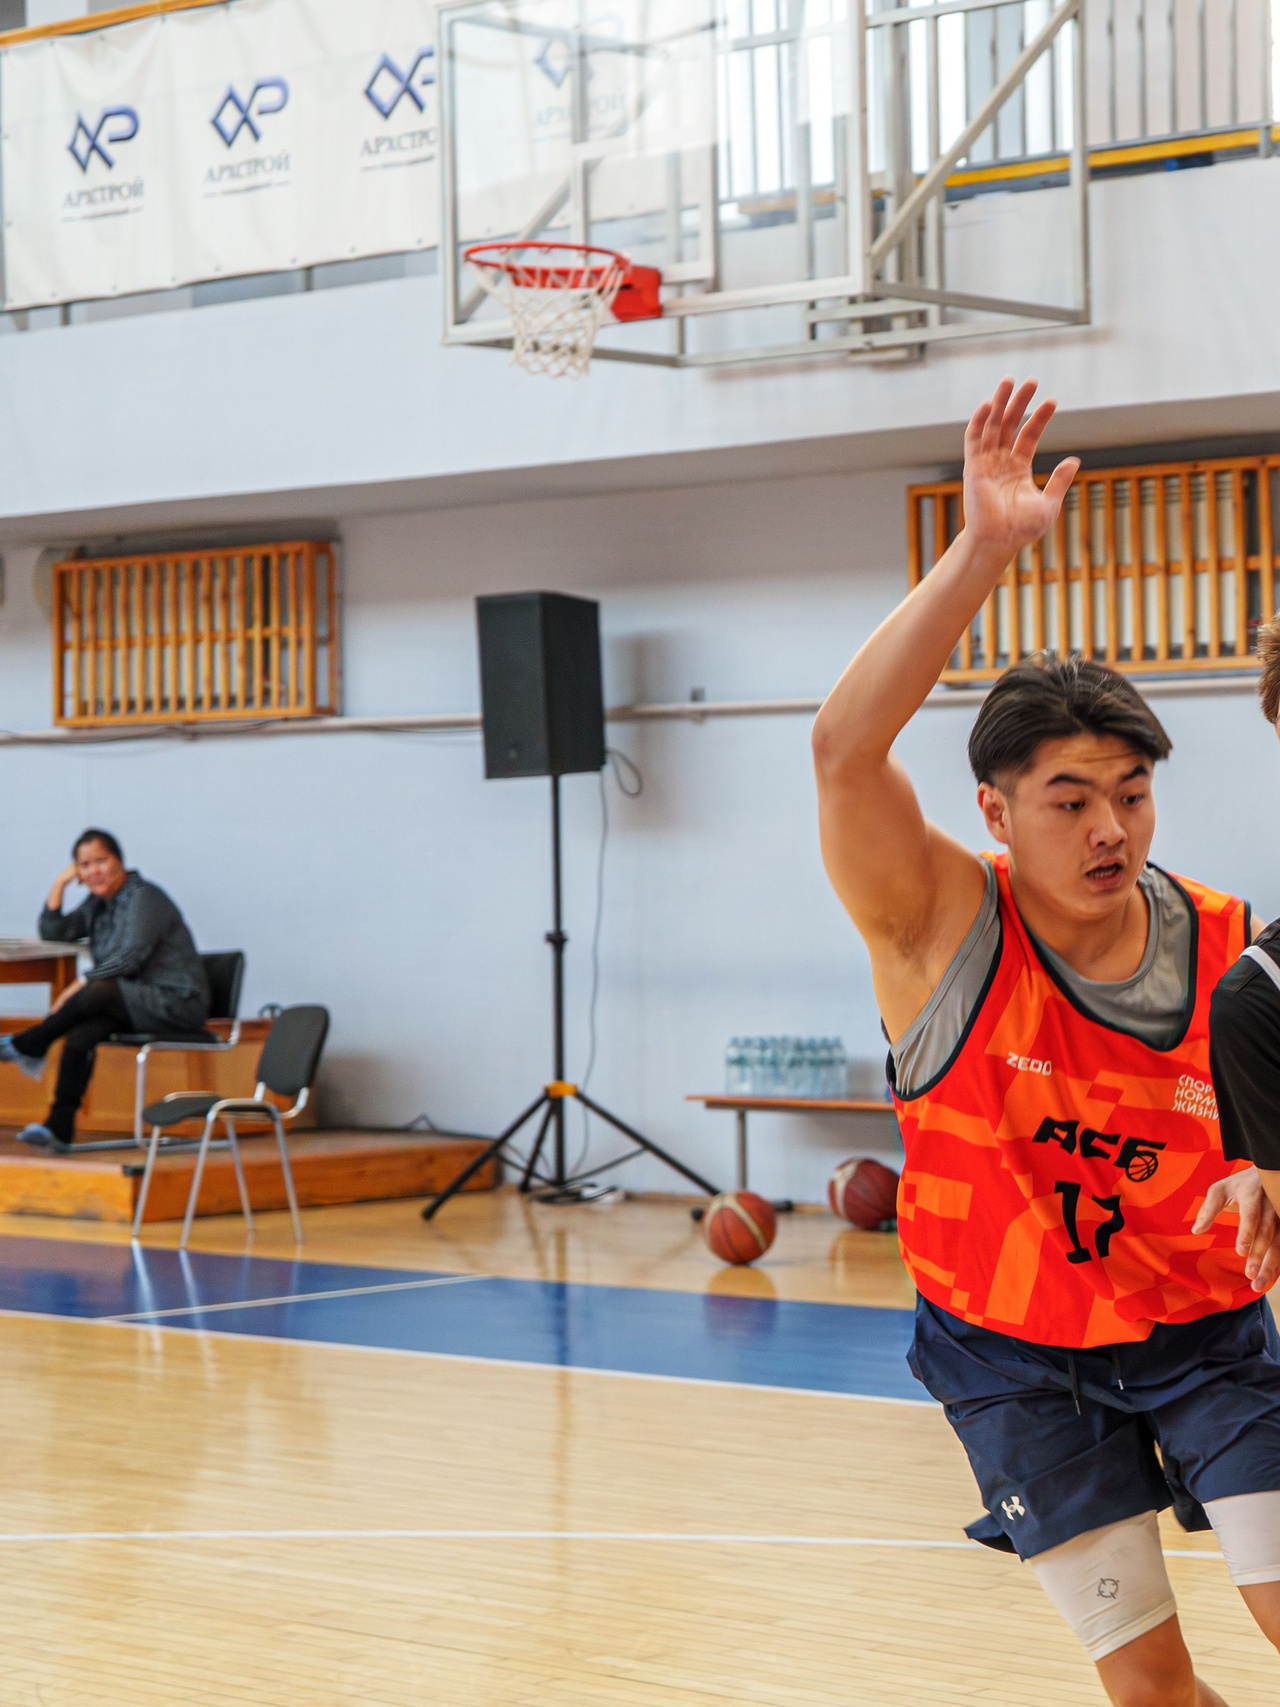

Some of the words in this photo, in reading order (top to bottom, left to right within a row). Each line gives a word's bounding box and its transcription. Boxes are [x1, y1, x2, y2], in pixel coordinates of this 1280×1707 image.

[360, 127, 440, 156] АРХСТРО
[1006, 1051, 1052, 1076] ZEDO
[1174, 1086, 1217, 1107] НОРМ
[1178, 1074, 1215, 1095] СПОР
[1054, 1180, 1125, 1264] 17
